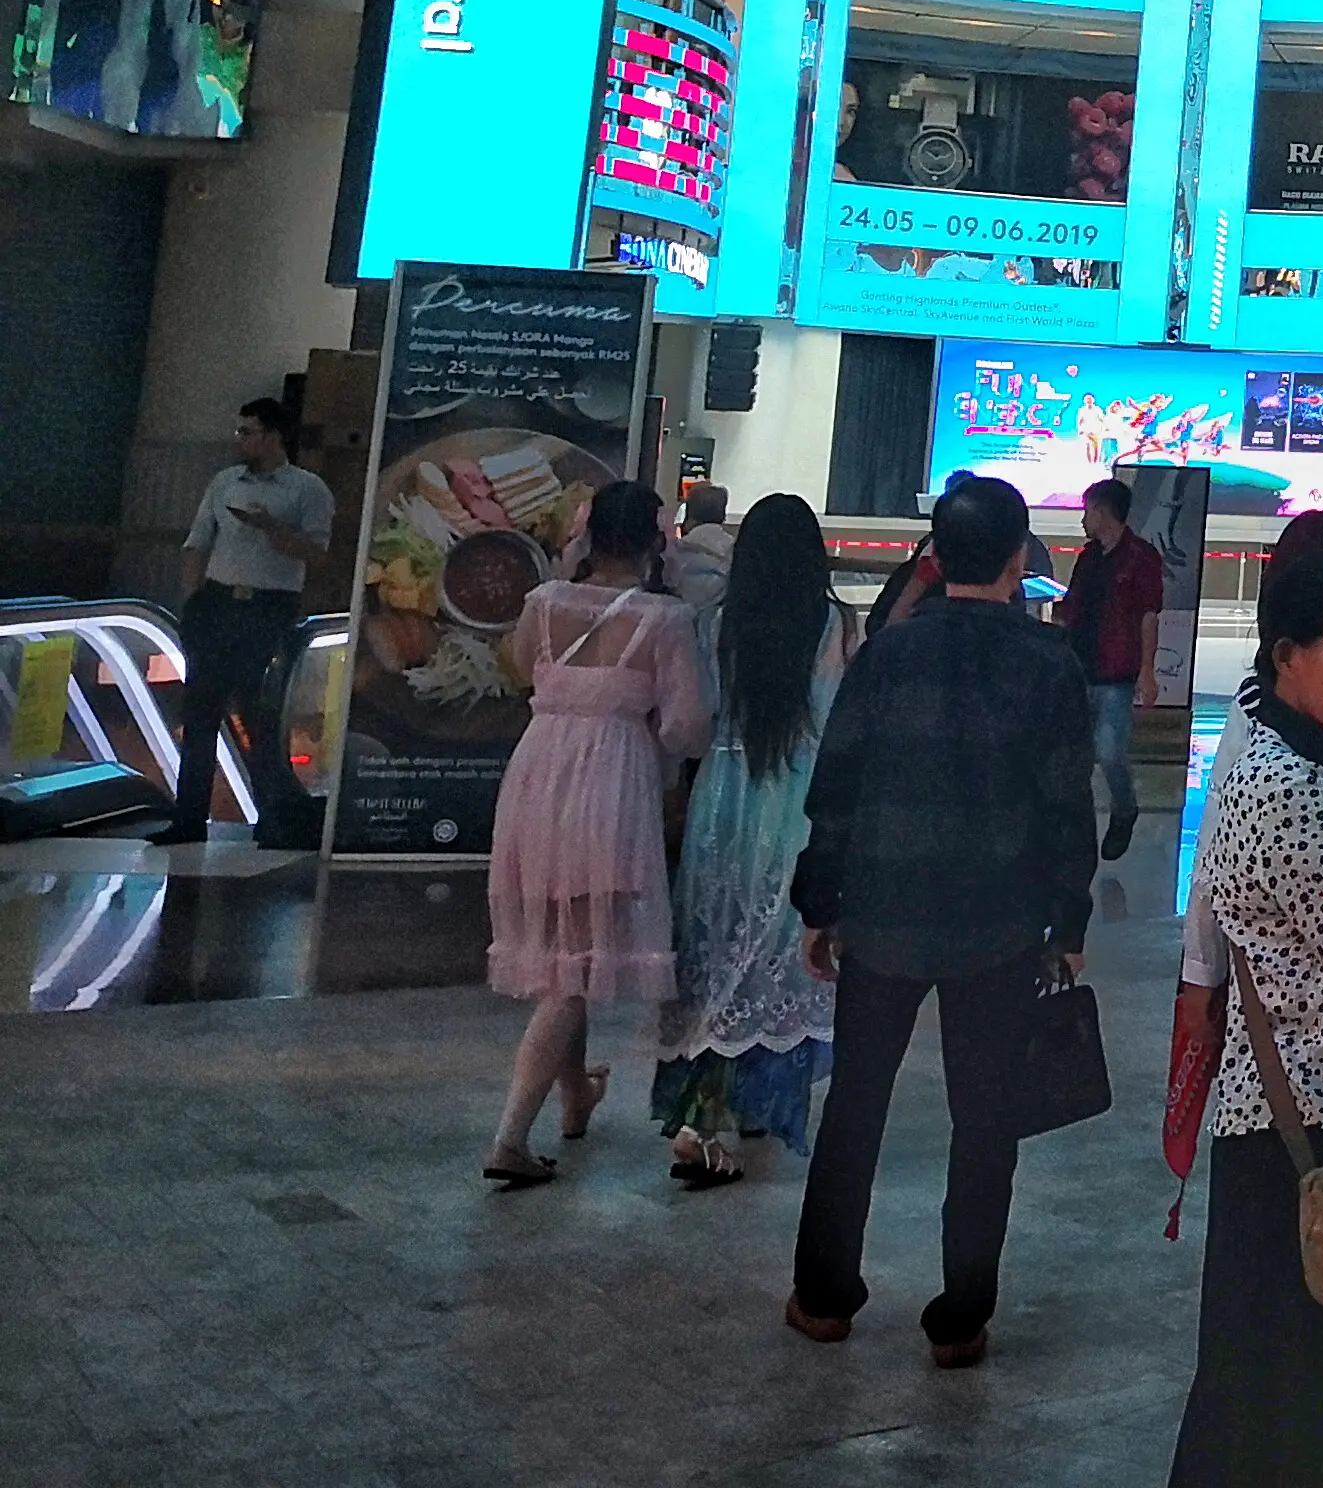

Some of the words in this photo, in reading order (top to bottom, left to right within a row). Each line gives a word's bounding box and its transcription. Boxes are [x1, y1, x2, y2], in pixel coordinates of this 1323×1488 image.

[840, 205, 914, 232] 24.05
[946, 215, 1099, 246] 09.06.2019
[861, 289, 903, 304] Genting
[906, 295, 959, 308] Highlands
[962, 297, 1010, 310] Premium
[924, 309, 979, 323] SkyAvenue
[982, 314, 1003, 323] and
[1006, 314, 1030, 325] First
[1031, 316, 1063, 327] World
[447, 360, 468, 375] 25
